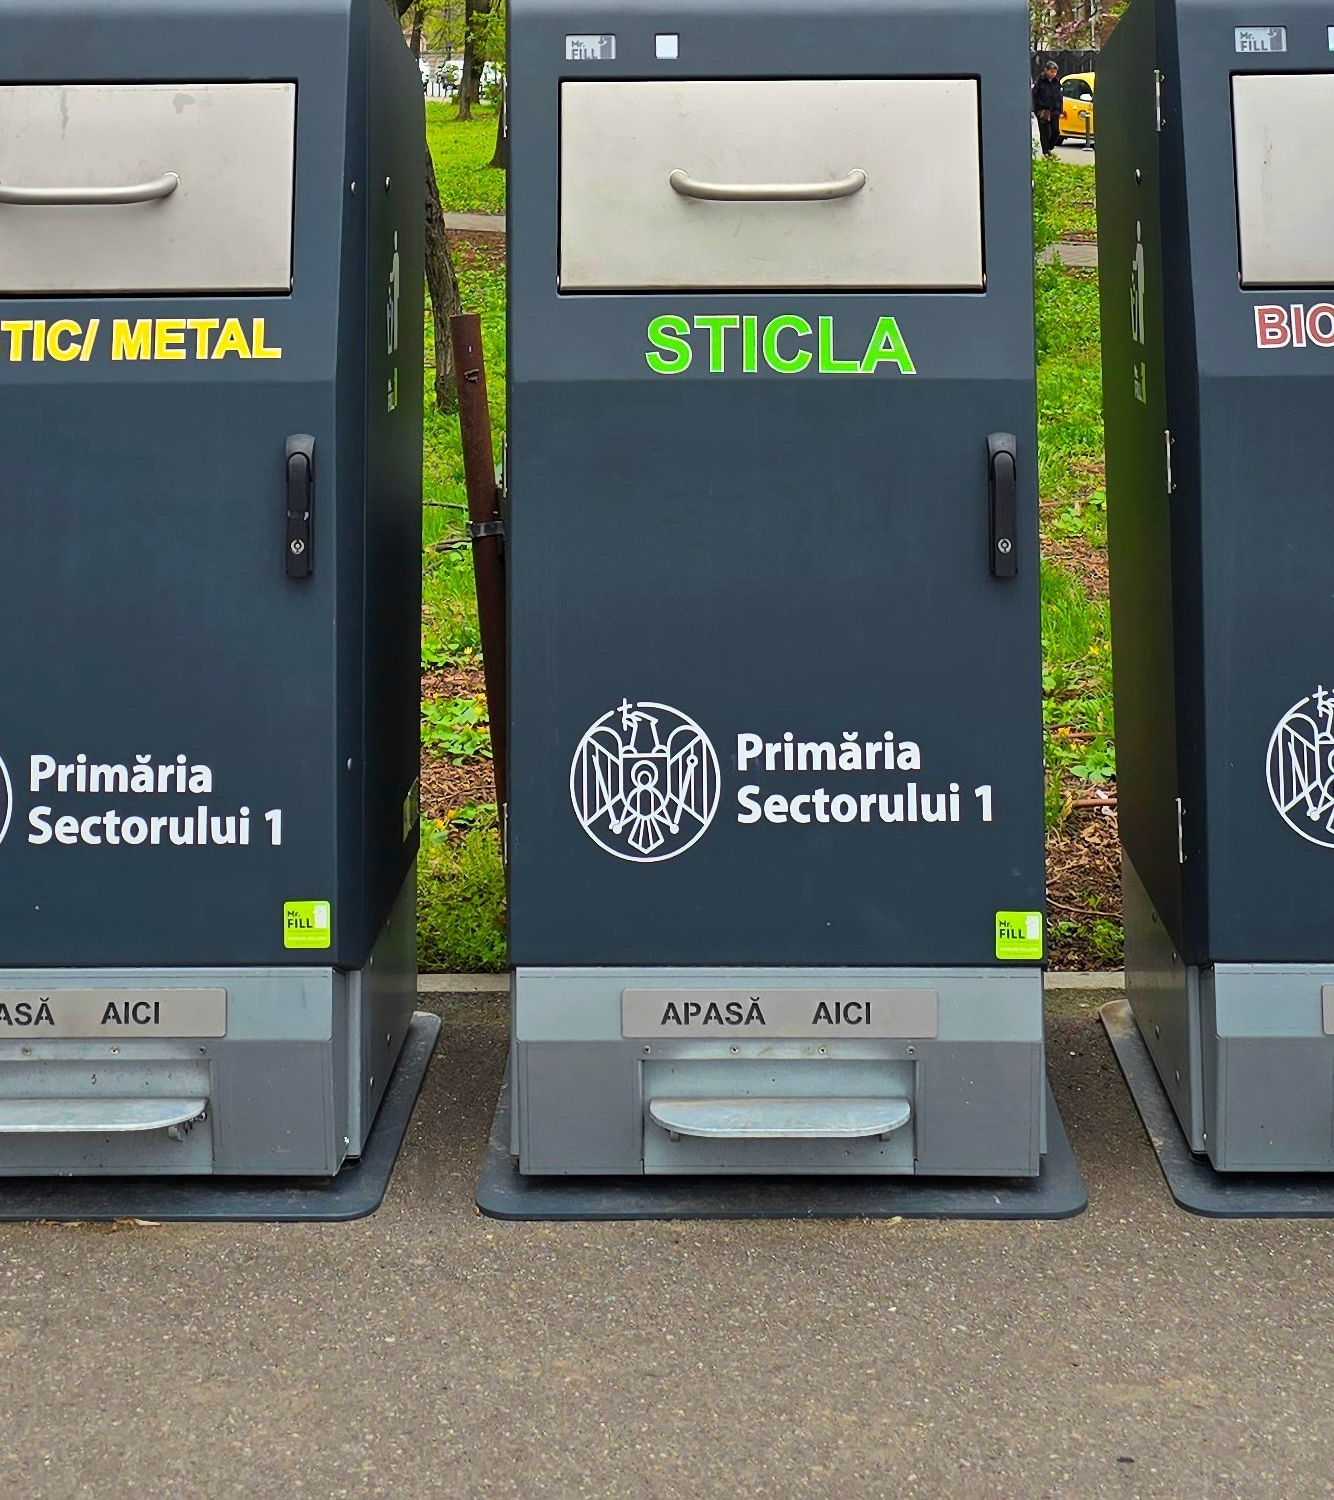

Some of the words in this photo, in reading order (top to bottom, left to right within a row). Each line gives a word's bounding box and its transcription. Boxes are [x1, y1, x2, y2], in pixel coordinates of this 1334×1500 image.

[572, 48, 597, 59] FILL
[1241, 40, 1268, 51] FILL
[112, 318, 282, 360] METAL
[645, 314, 916, 374] STICLA
[737, 730, 921, 771] Primăria
[30, 753, 213, 794] Primăria
[737, 783, 960, 824] Sectorului
[974, 784, 993, 822] 1
[28, 806, 250, 845] Sectorului
[264, 808, 283, 845] 1
[287, 918, 313, 928] FILL
[999, 928, 1025, 939] FILL
[101, 1001, 160, 1025] AICI
[661, 997, 767, 1026] APASĂ
[812, 1001, 871, 1025] AICI
